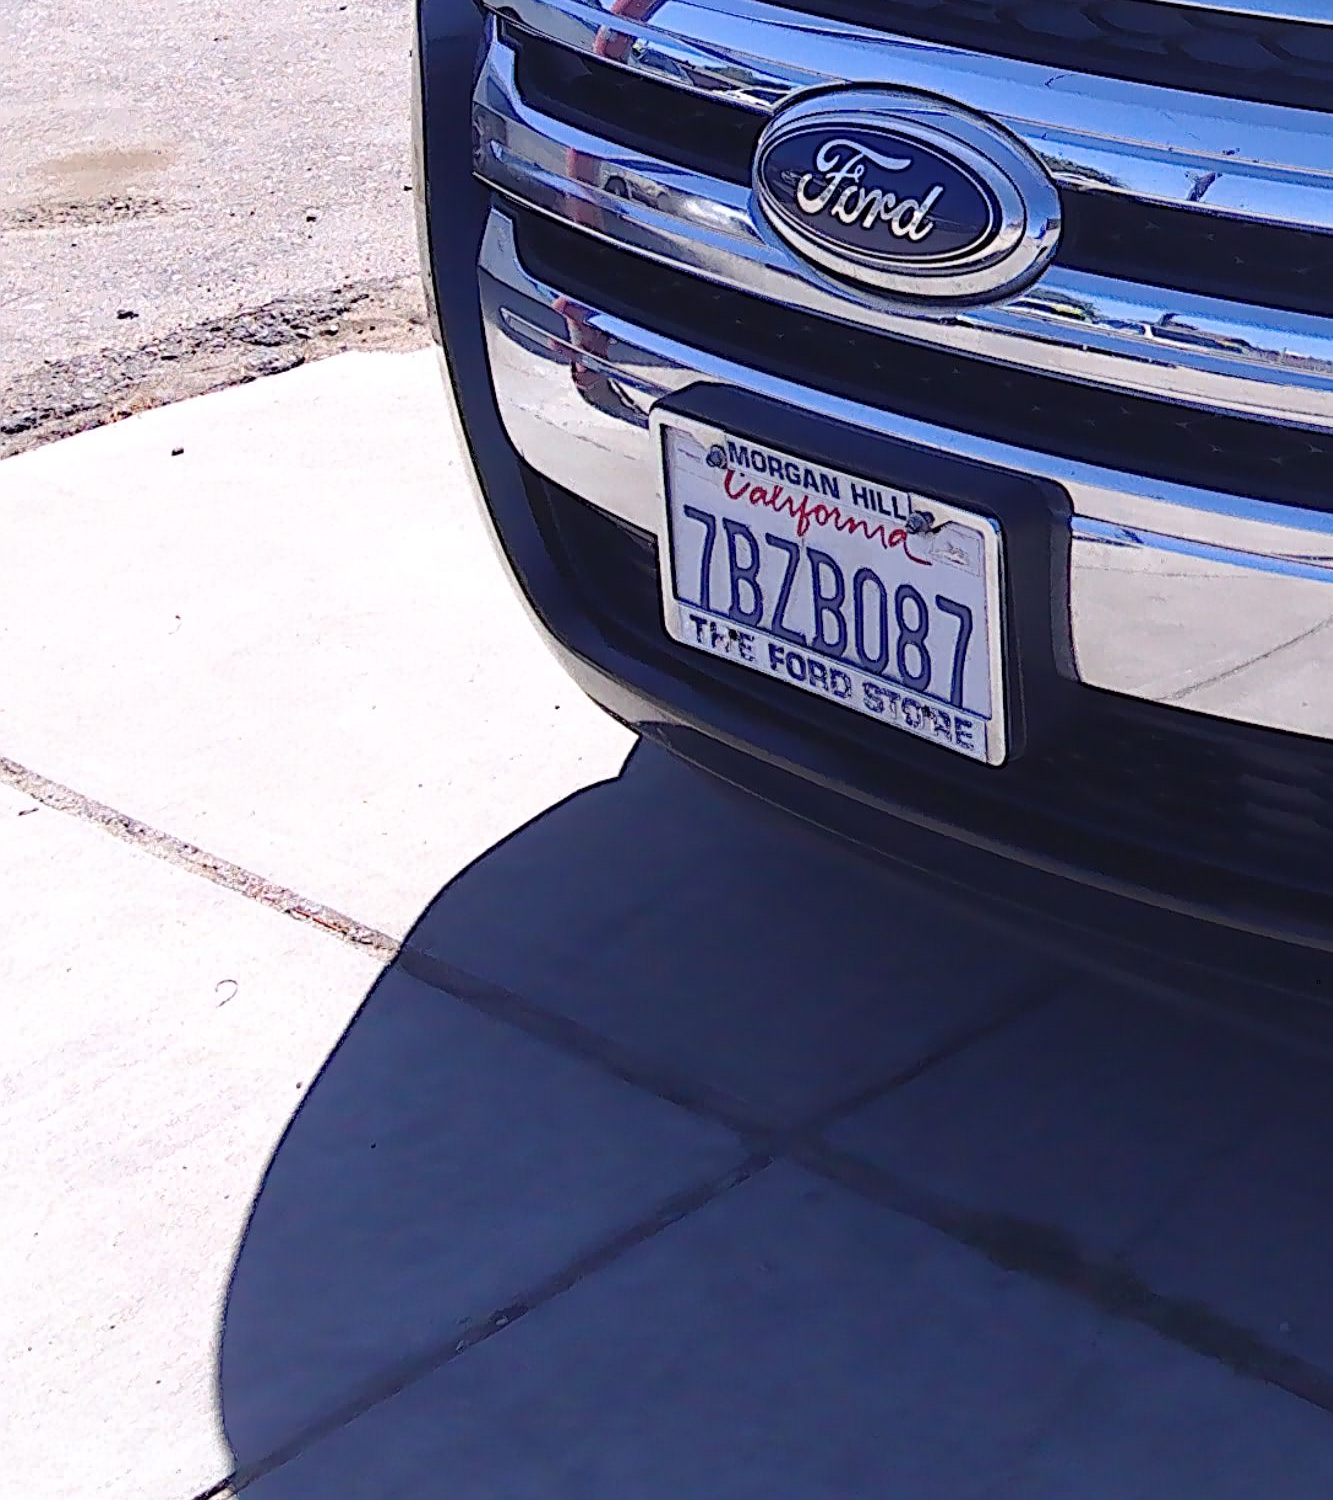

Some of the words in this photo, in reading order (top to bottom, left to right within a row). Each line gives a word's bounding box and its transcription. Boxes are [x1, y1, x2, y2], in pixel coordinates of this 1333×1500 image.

[796, 137, 944, 242] Ford
[723, 466, 934, 567] California
[724, 440, 841, 500] MORGAN
[851, 482, 912, 520] HILL
[683, 503, 974, 710] 7BZB087
[689, 614, 755, 662] THE
[767, 642, 853, 699] FORD
[861, 681, 976, 751] STORE
